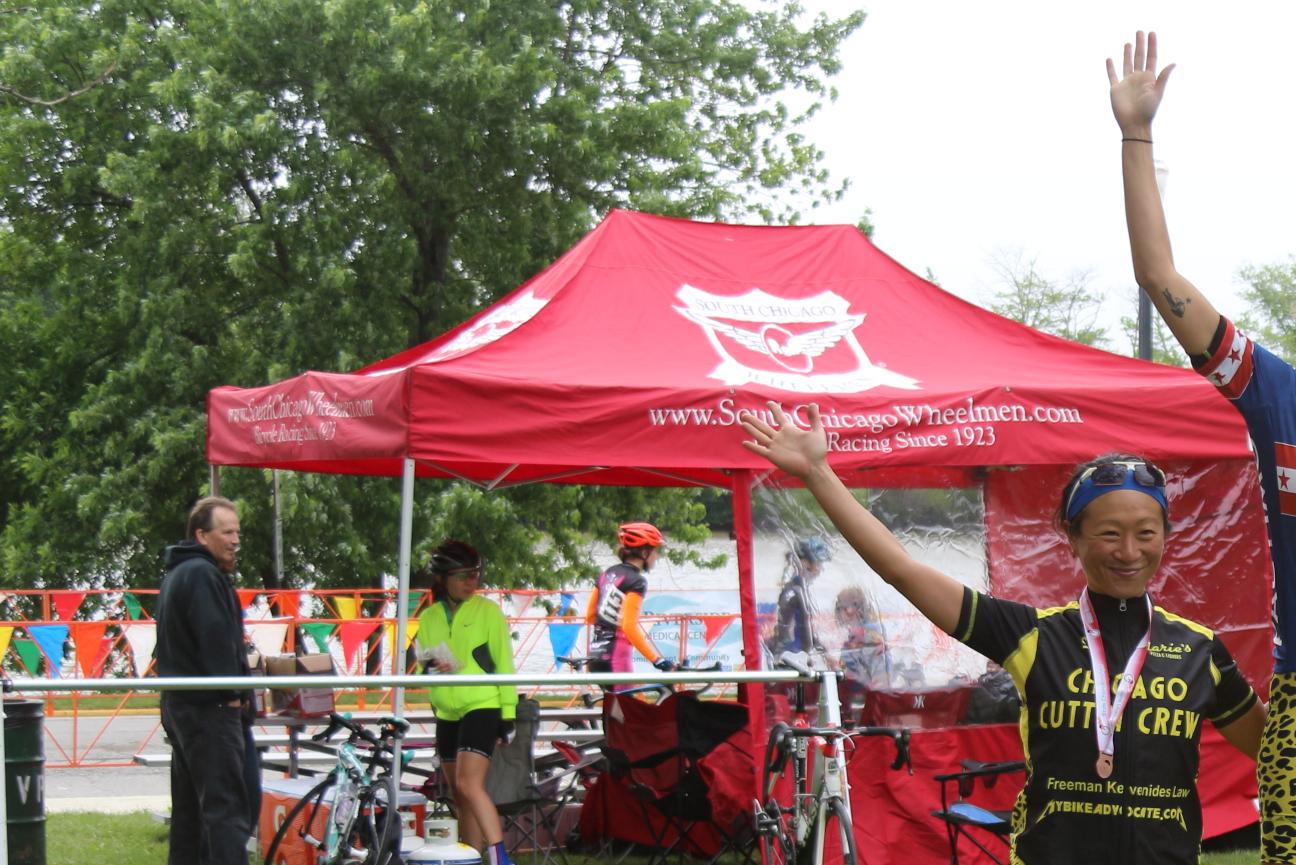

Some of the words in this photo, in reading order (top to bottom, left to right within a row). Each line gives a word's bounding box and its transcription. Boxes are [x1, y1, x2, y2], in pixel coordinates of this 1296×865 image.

[695, 298, 754, 316] SOUTH
[758, 304, 837, 319] CHICAGO
[827, 431, 892, 453] Racing
[895, 431, 948, 448] Since
[953, 426, 996, 447] 1923
[644, 631, 682, 641] MEDICA
[1067, 668, 1188, 702] CHCAGO
[1040, 700, 1122, 732] CUTT
[1138, 707, 1200, 740] CREW
[1048, 778, 1102, 793] Freeman
[1172, 786, 1190, 799] Law
